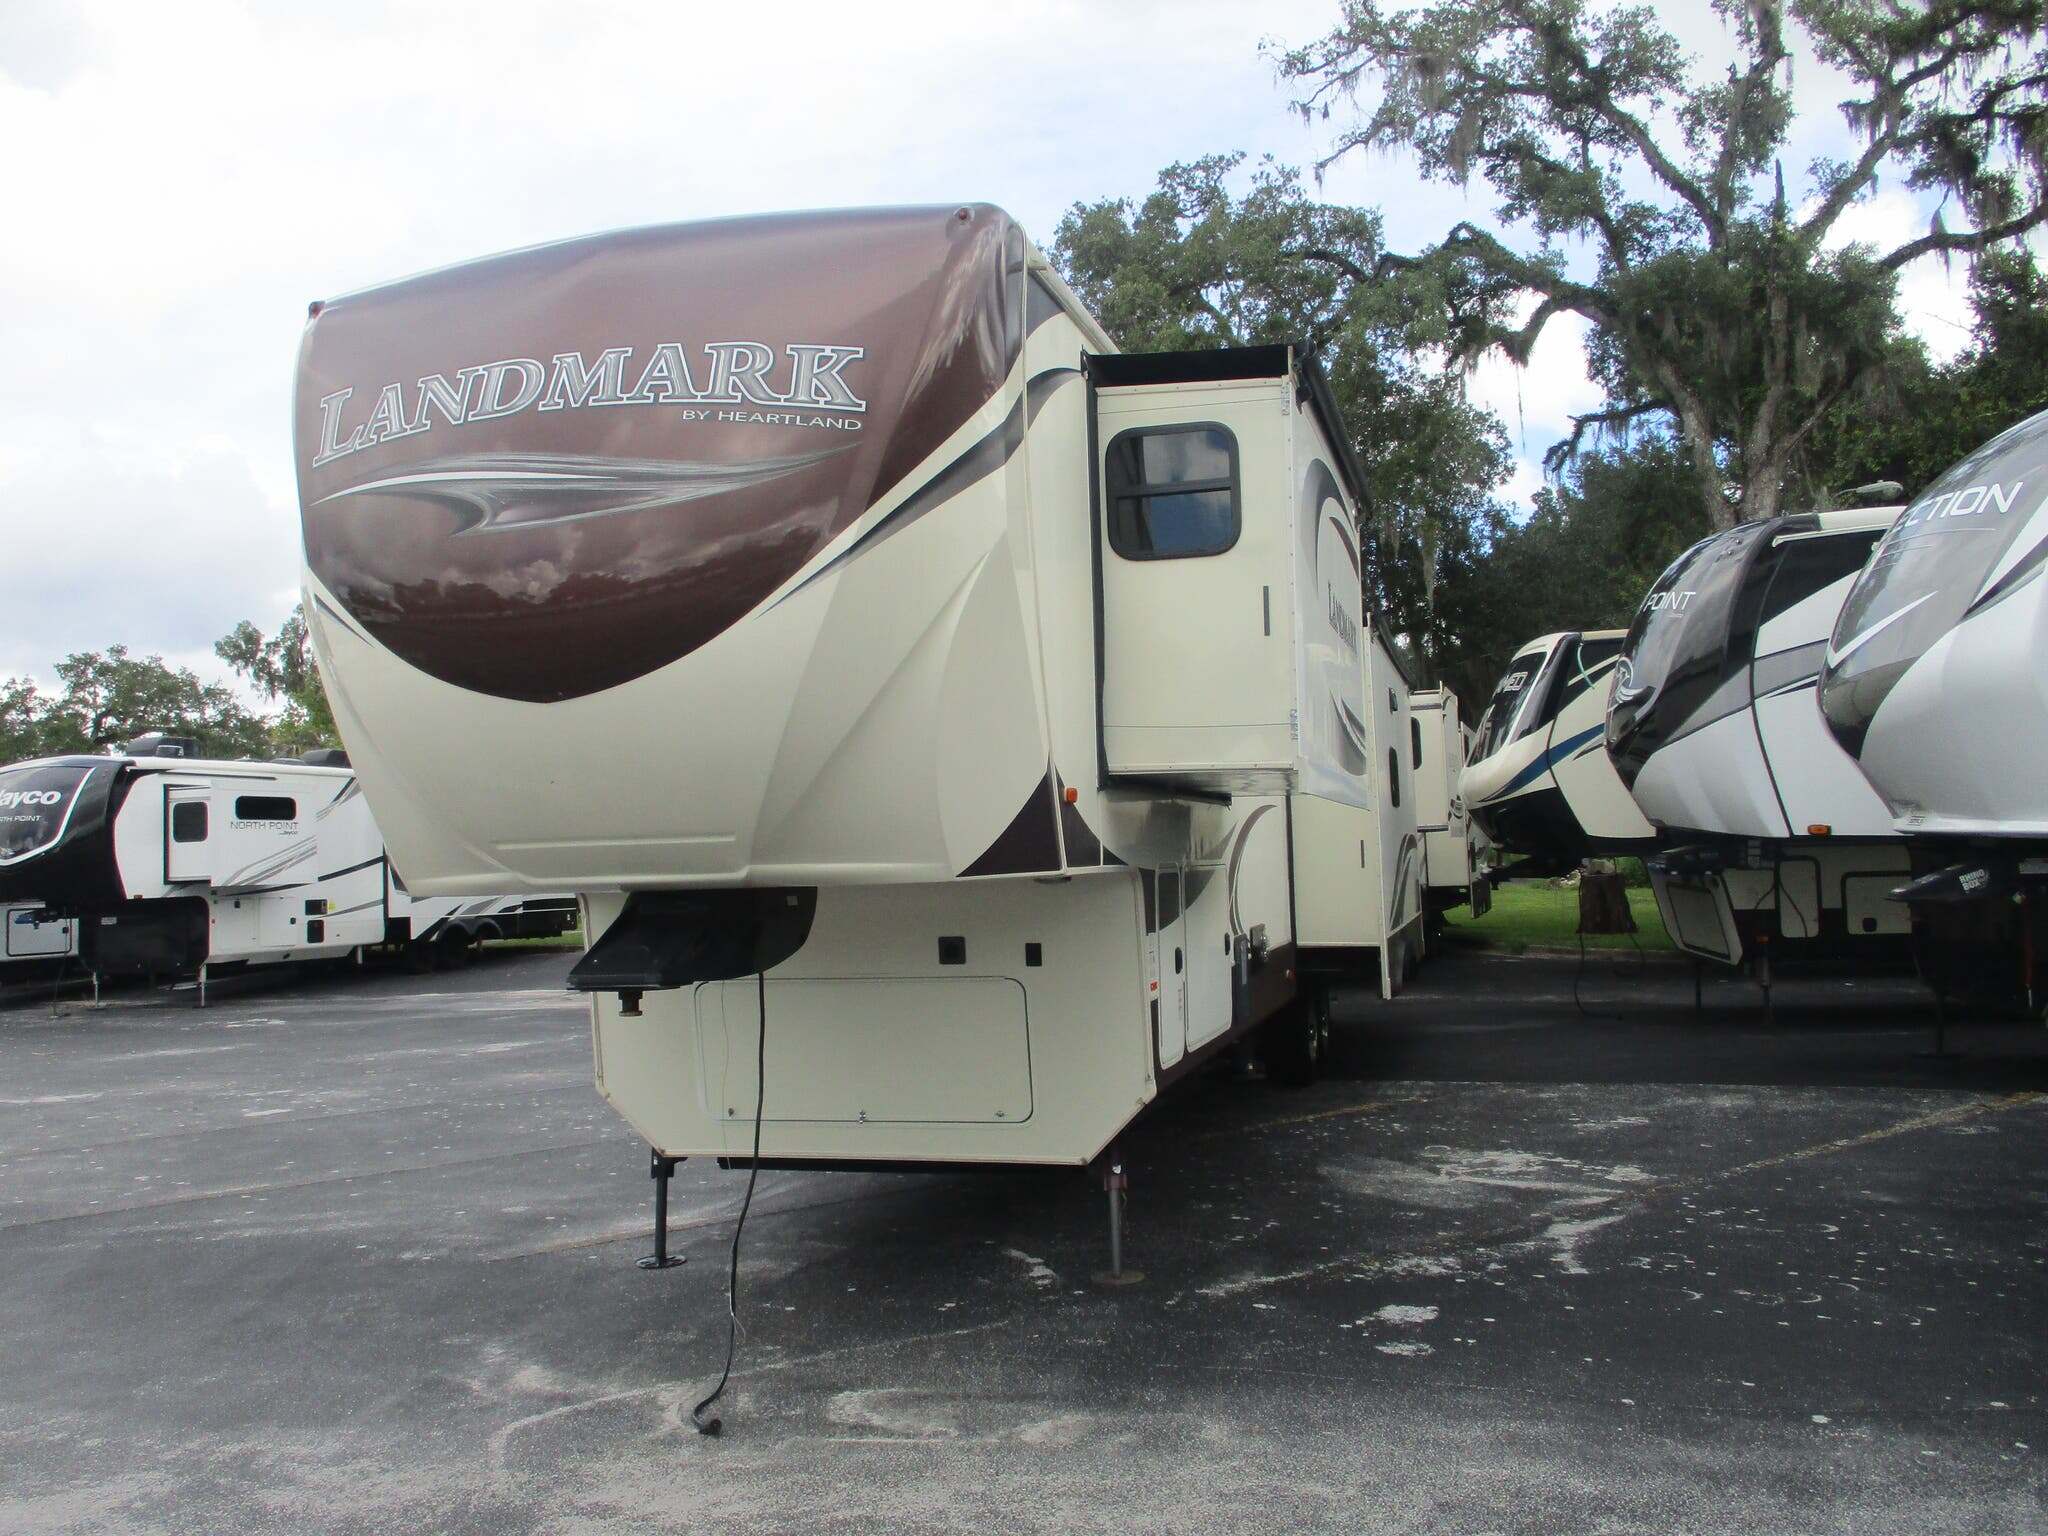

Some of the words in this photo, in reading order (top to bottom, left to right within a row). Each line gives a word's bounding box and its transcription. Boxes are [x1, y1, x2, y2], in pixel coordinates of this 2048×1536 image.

[312, 341, 867, 468] LANDMARK
[682, 409, 711, 420] BY
[718, 410, 863, 431] HEARTLAND
[1643, 591, 1697, 612] POINT
[230, 821, 266, 830] NORTH
[269, 821, 299, 830] POINT
[1959, 868, 1985, 884] RHINO
[1962, 879, 1981, 891] BOX
